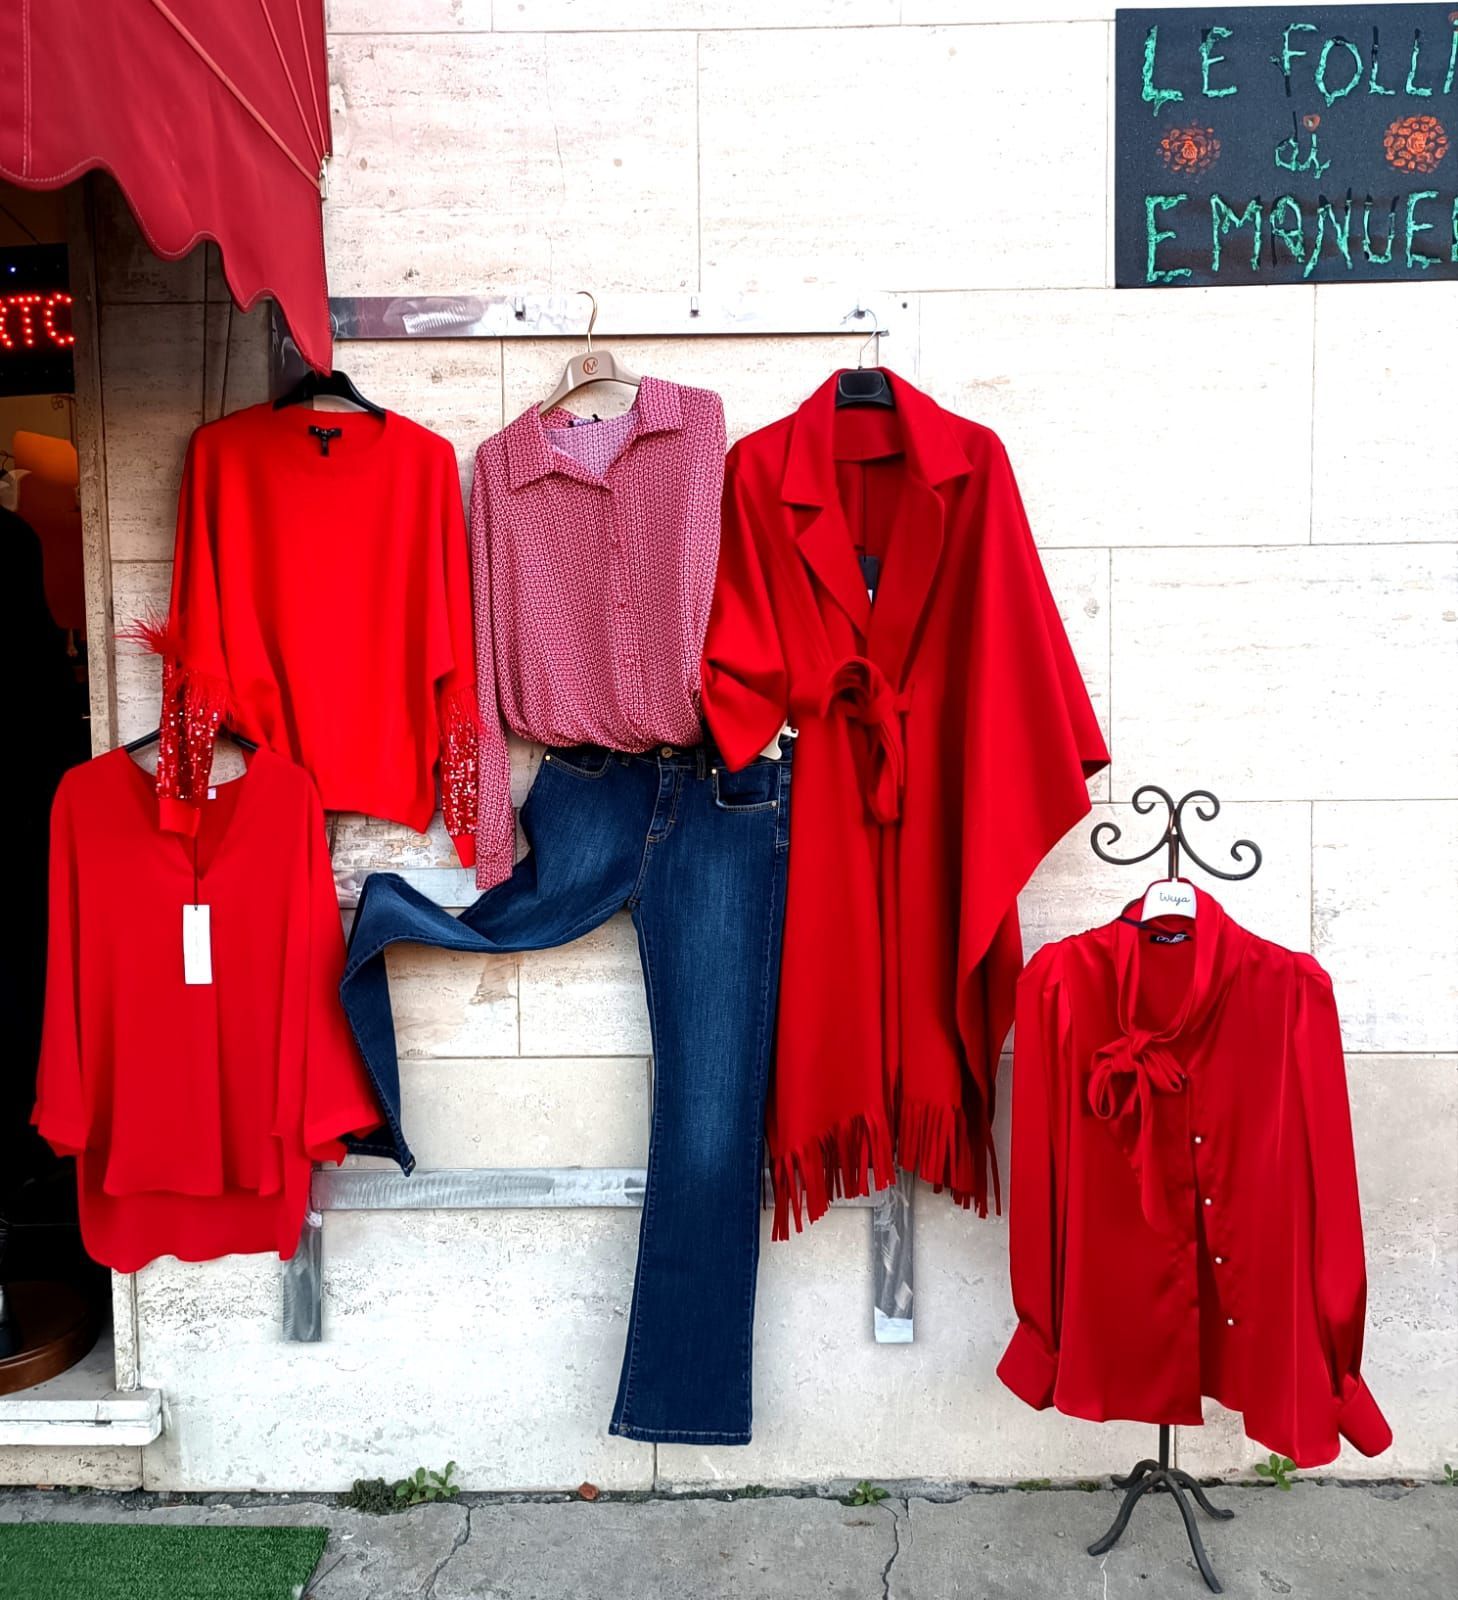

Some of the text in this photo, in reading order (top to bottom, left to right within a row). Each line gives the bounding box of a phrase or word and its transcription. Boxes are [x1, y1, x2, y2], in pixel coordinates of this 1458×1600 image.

[1141, 25, 1238, 116] LE
[1274, 111, 1332, 179] di
[1144, 188, 1458, 283] EMANUE
